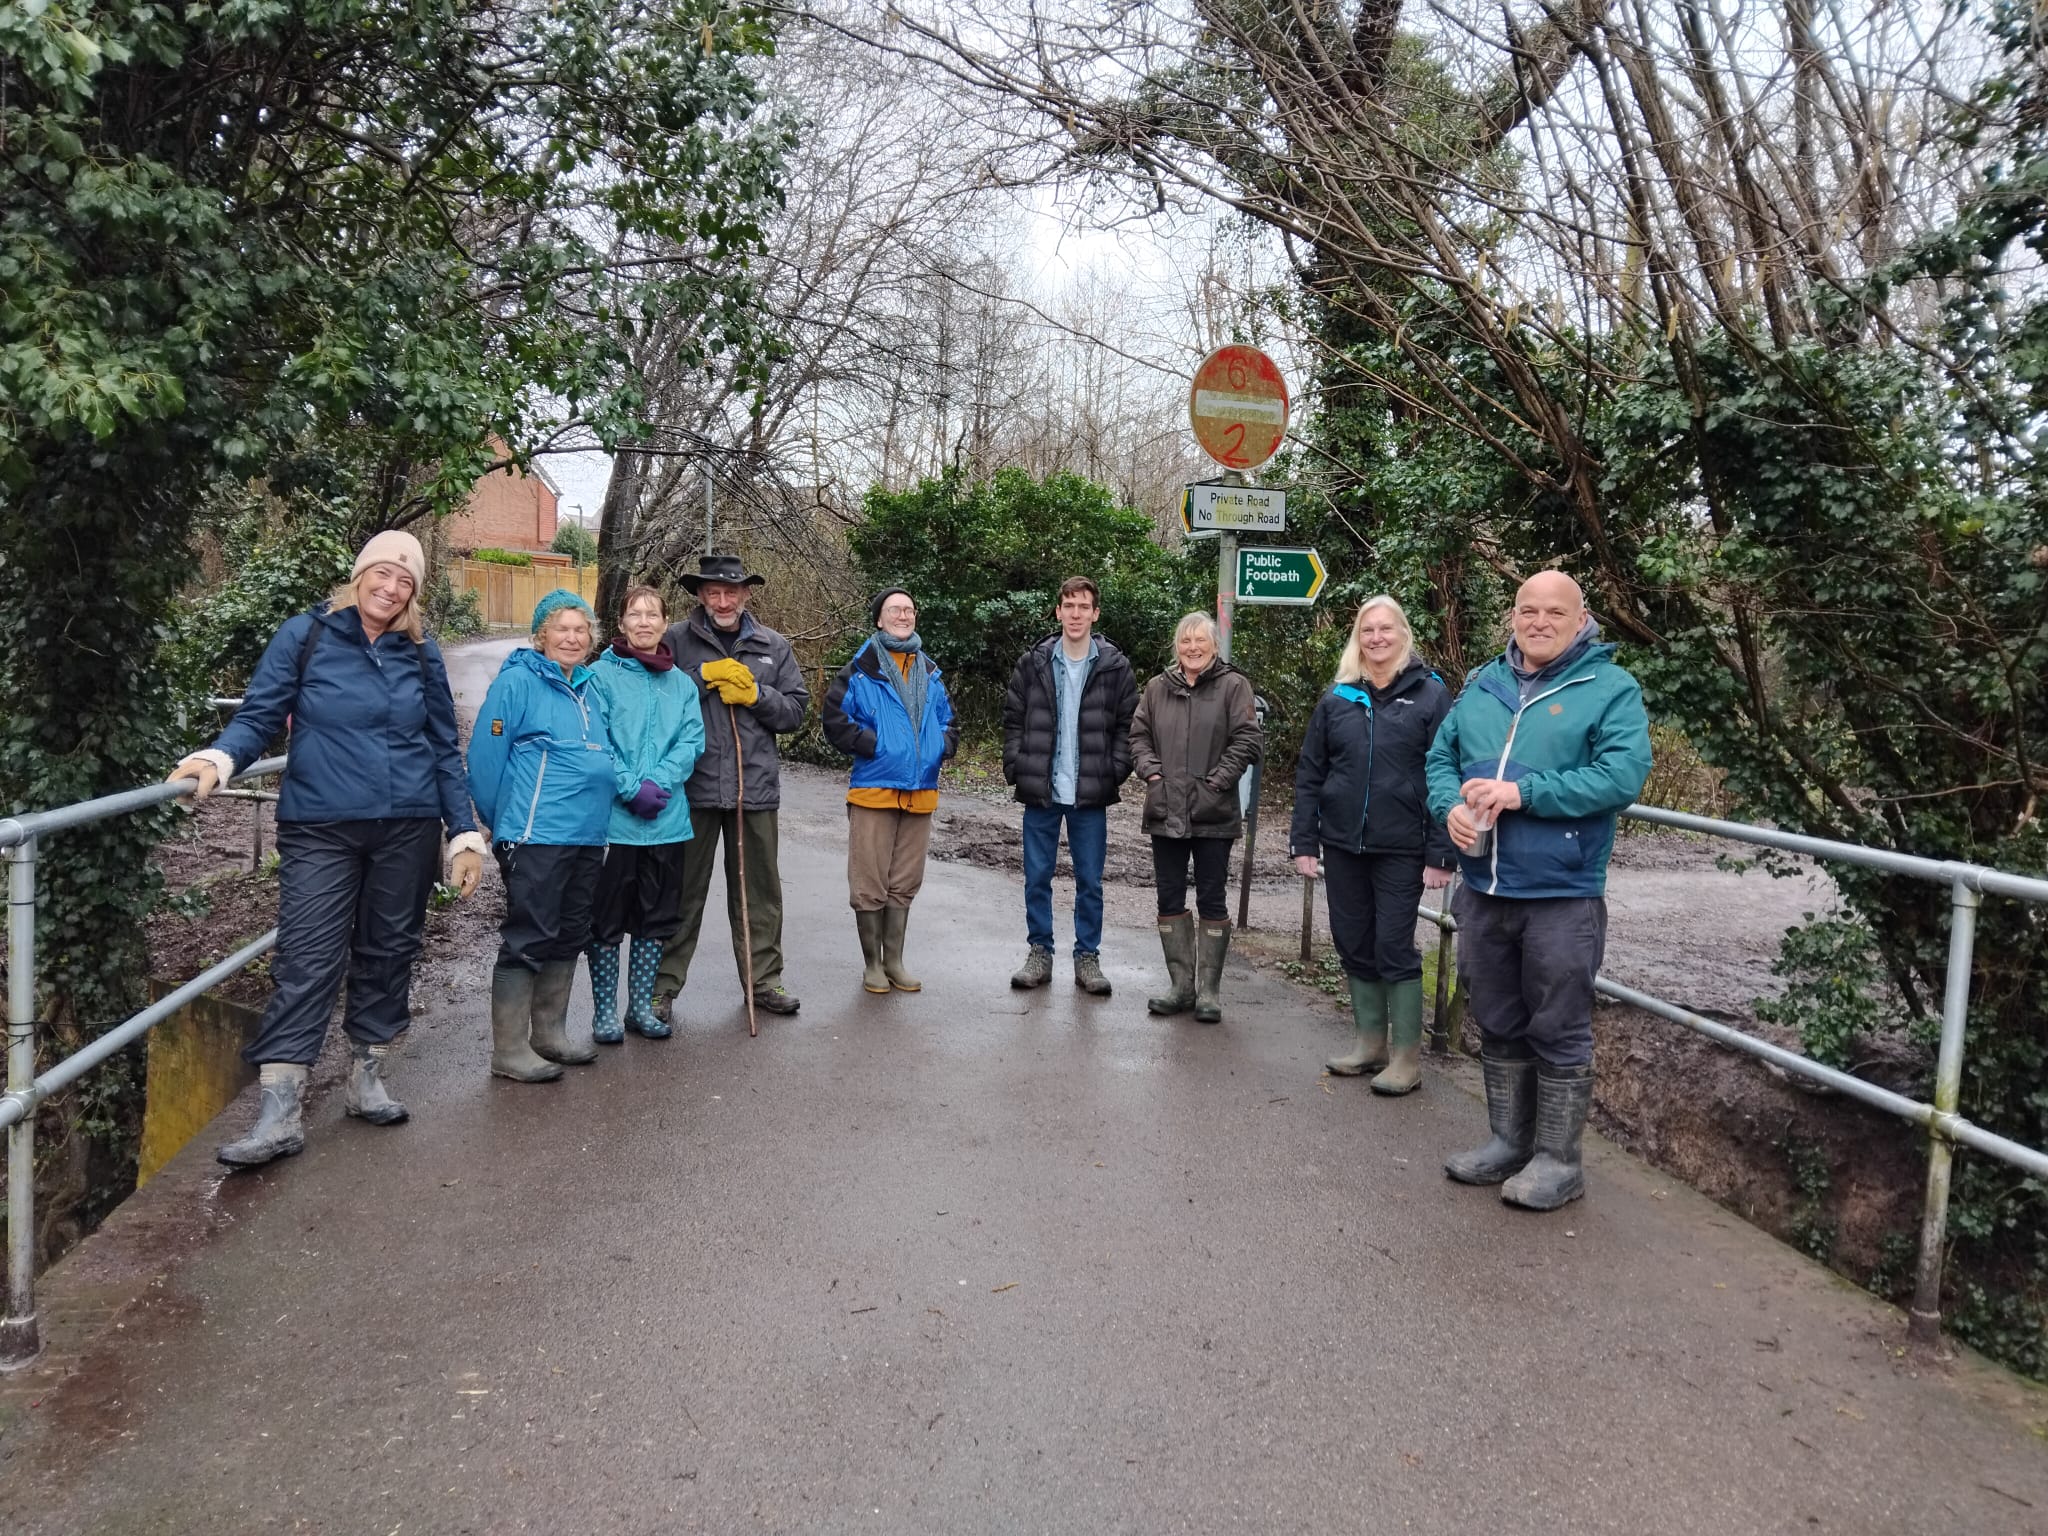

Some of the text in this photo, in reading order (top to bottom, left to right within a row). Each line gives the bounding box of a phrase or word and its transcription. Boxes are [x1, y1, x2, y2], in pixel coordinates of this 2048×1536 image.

[1228, 356, 1247, 391] 6
[1223, 422, 1250, 463] 2
[1210, 492, 1270, 507] Private Road
[1198, 509, 1280, 525] No Through Road
[1246, 553, 1282, 567] Public
[1245, 568, 1300, 583] Footpath
